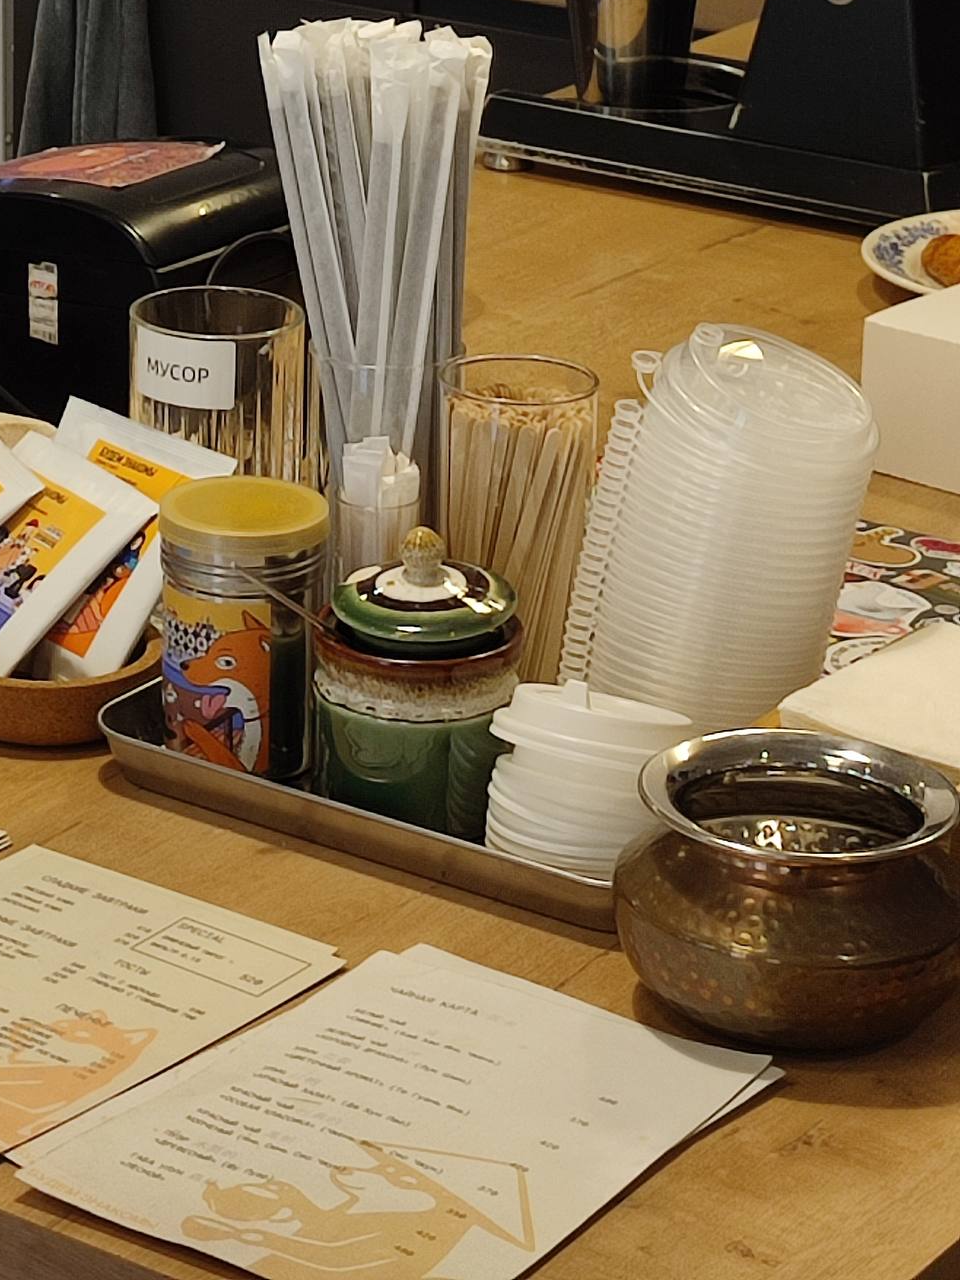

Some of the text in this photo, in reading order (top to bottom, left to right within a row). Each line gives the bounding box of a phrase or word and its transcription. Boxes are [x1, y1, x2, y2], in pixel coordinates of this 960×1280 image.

[147, 356, 209, 383] МУСОР
[92, 893, 148, 914] ЗАВТРАКИ
[20, 925, 77, 947] ЗАВТРАКИ
[178, 923, 224, 943] SPECIAL
[391, 987, 478, 1016] ЧАЙНАЯ КАРТА
